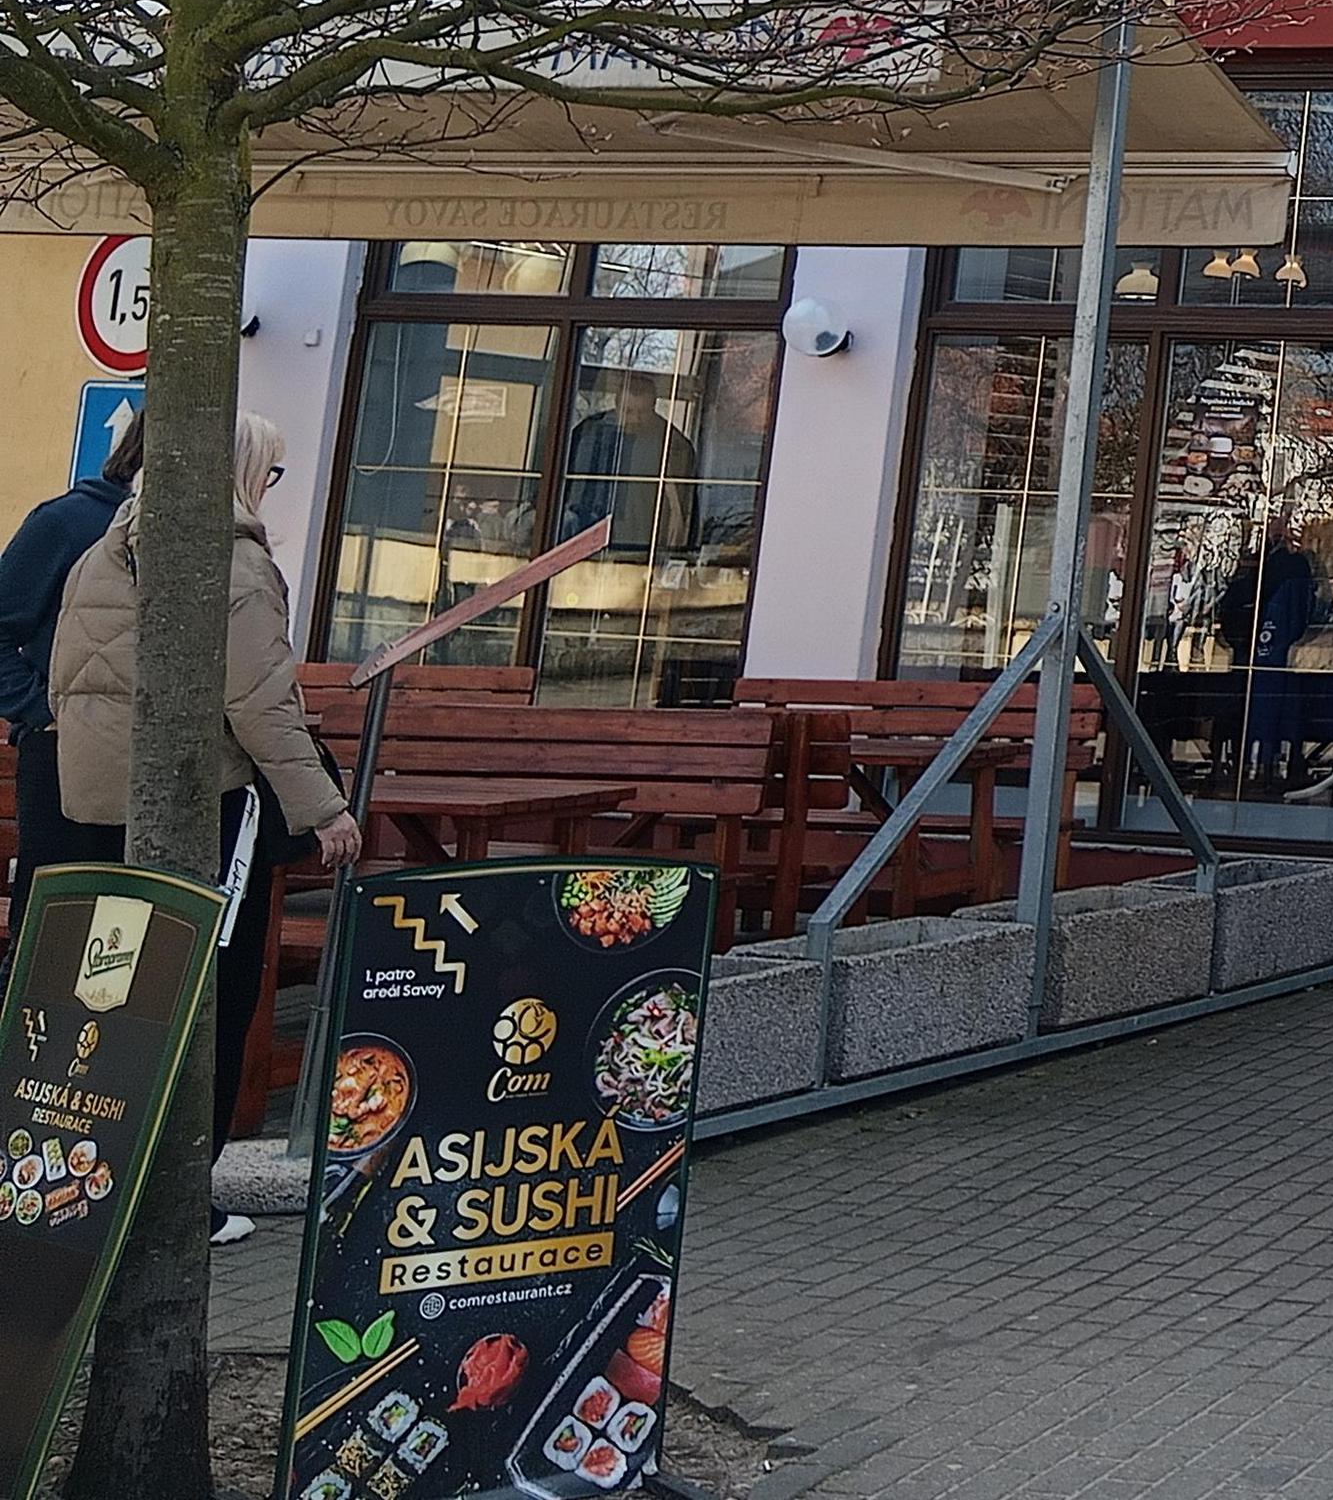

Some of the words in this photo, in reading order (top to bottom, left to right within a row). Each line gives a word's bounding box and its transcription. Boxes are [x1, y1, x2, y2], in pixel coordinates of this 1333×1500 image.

[363, 983, 401, 999] areál
[402, 982, 446, 999] Savoy
[375, 968, 416, 985] patro
[14, 1078, 72, 1109] ASIJSKÁ
[70, 1090, 82, 1110] &
[83, 1093, 127, 1121] SUSHI
[487, 1066, 551, 1102] Com
[32, 1107, 95, 1134] RESTAURACE
[390, 1103, 625, 1189] ASIJSKÁ
[386, 1195, 438, 1249] &
[452, 1174, 619, 1242] SUSHI
[389, 1241, 605, 1288] Restaurace
[448, 1281, 573, 1311] comrestaurant.cz
